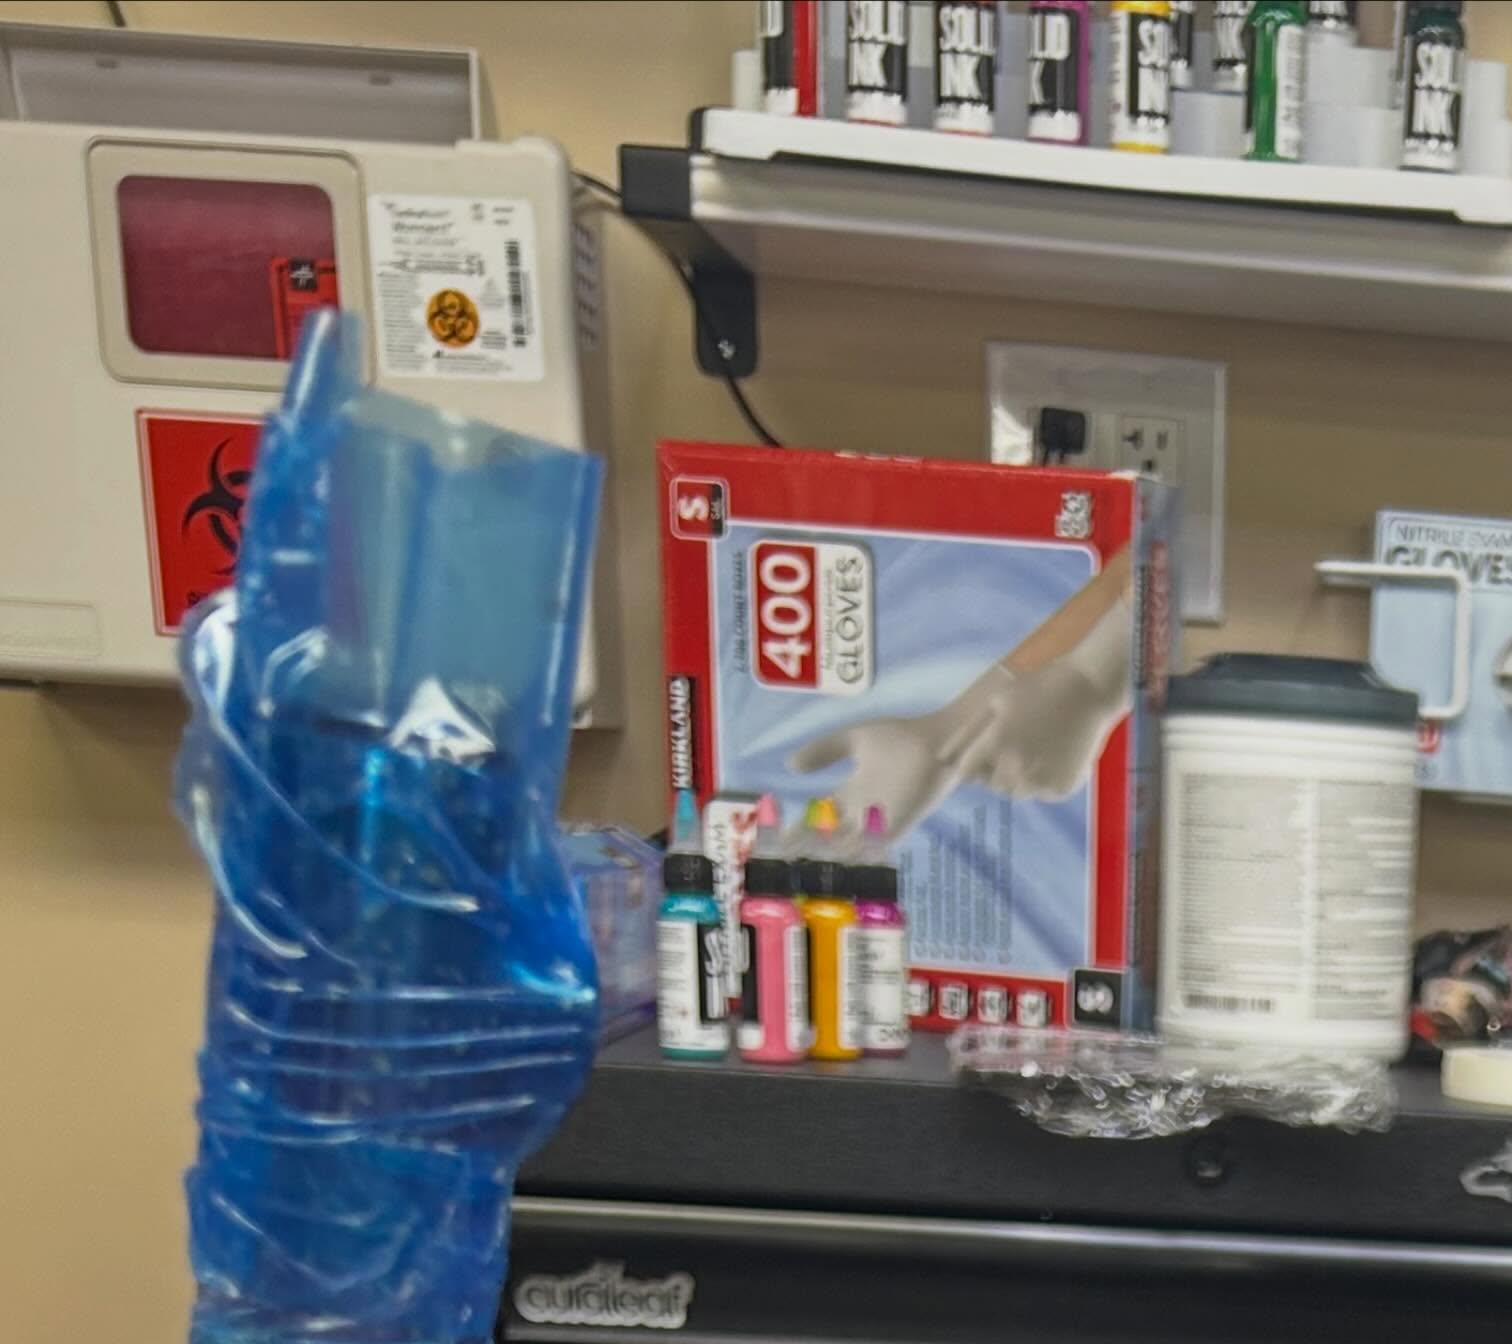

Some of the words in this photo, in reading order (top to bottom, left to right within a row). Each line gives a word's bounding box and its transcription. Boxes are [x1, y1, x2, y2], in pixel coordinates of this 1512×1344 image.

[939, 52, 985, 99] INK
[678, 494, 710, 521] S
[759, 553, 813, 680] 400
[835, 556, 866, 685] GLOVES
[668, 677, 693, 789] KIRKLAND
